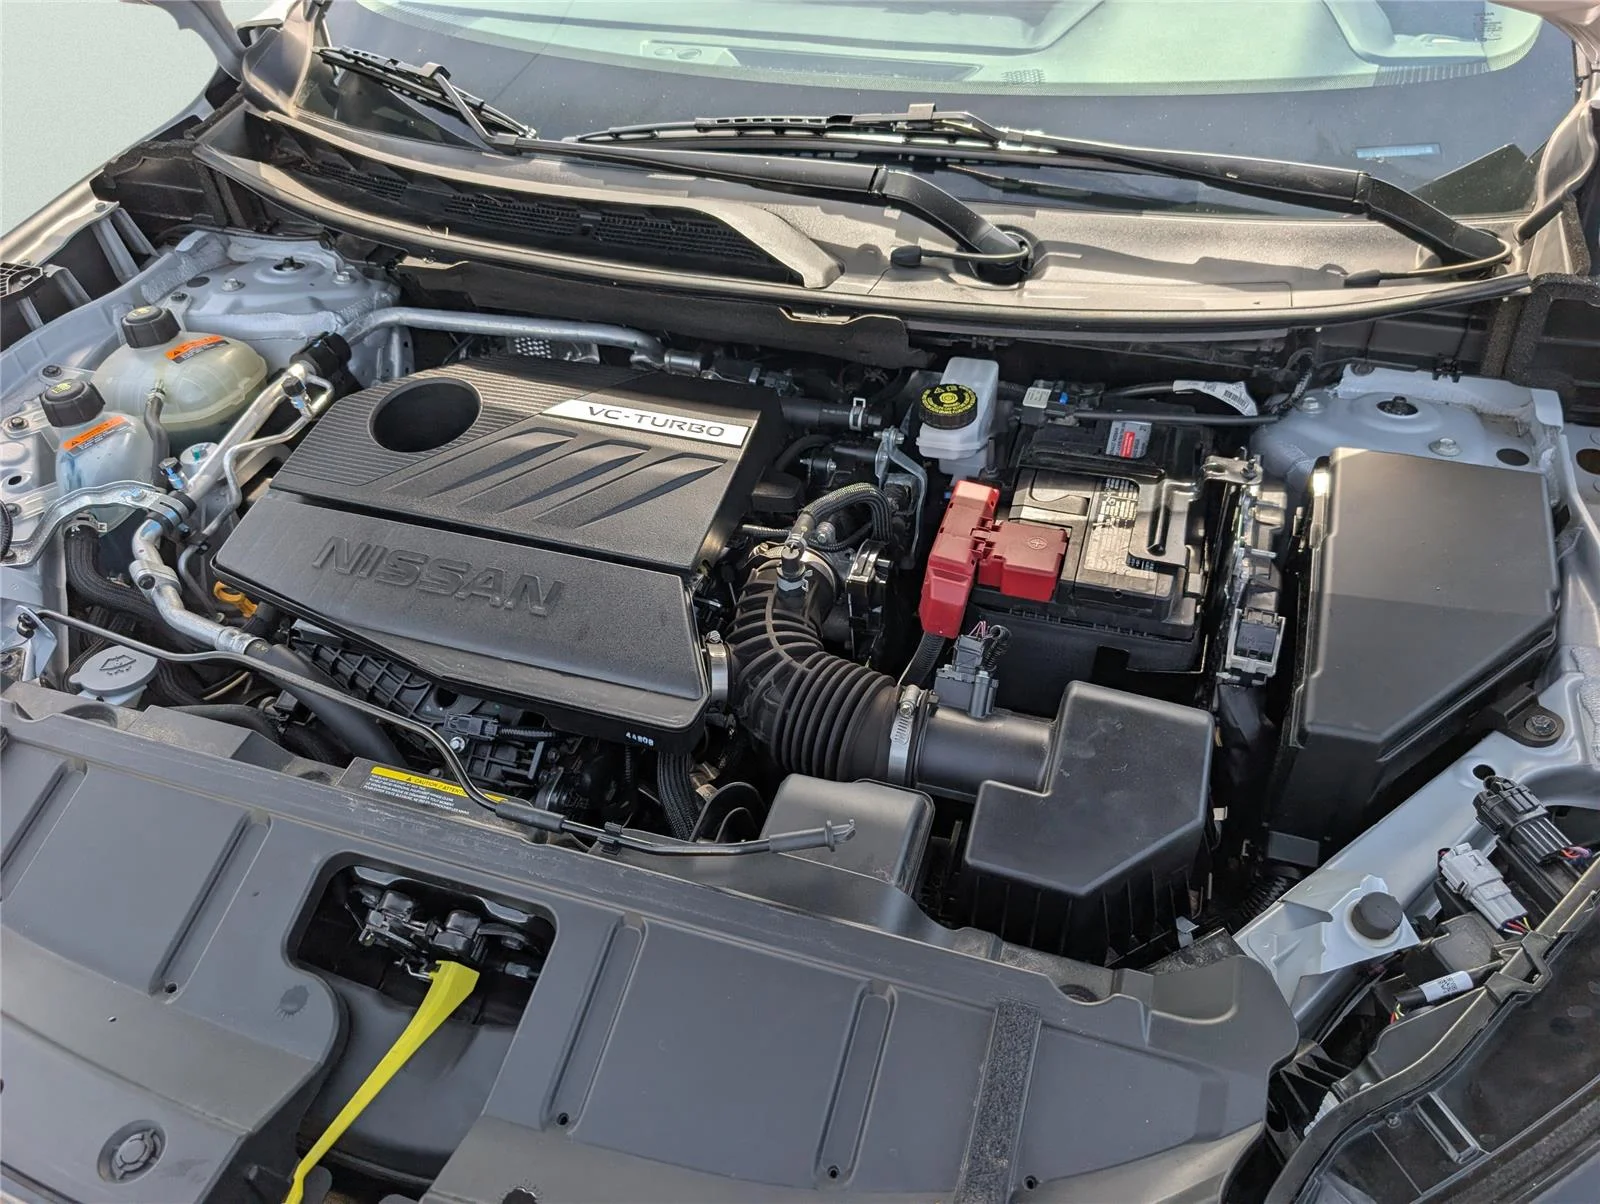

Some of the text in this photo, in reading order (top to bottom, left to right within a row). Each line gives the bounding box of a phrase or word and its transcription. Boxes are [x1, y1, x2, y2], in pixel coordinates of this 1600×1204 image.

[589, 406, 725, 437] VC-TURBO
[311, 535, 565, 617] NISSAN
[414, 778, 438, 788] CAUTION
